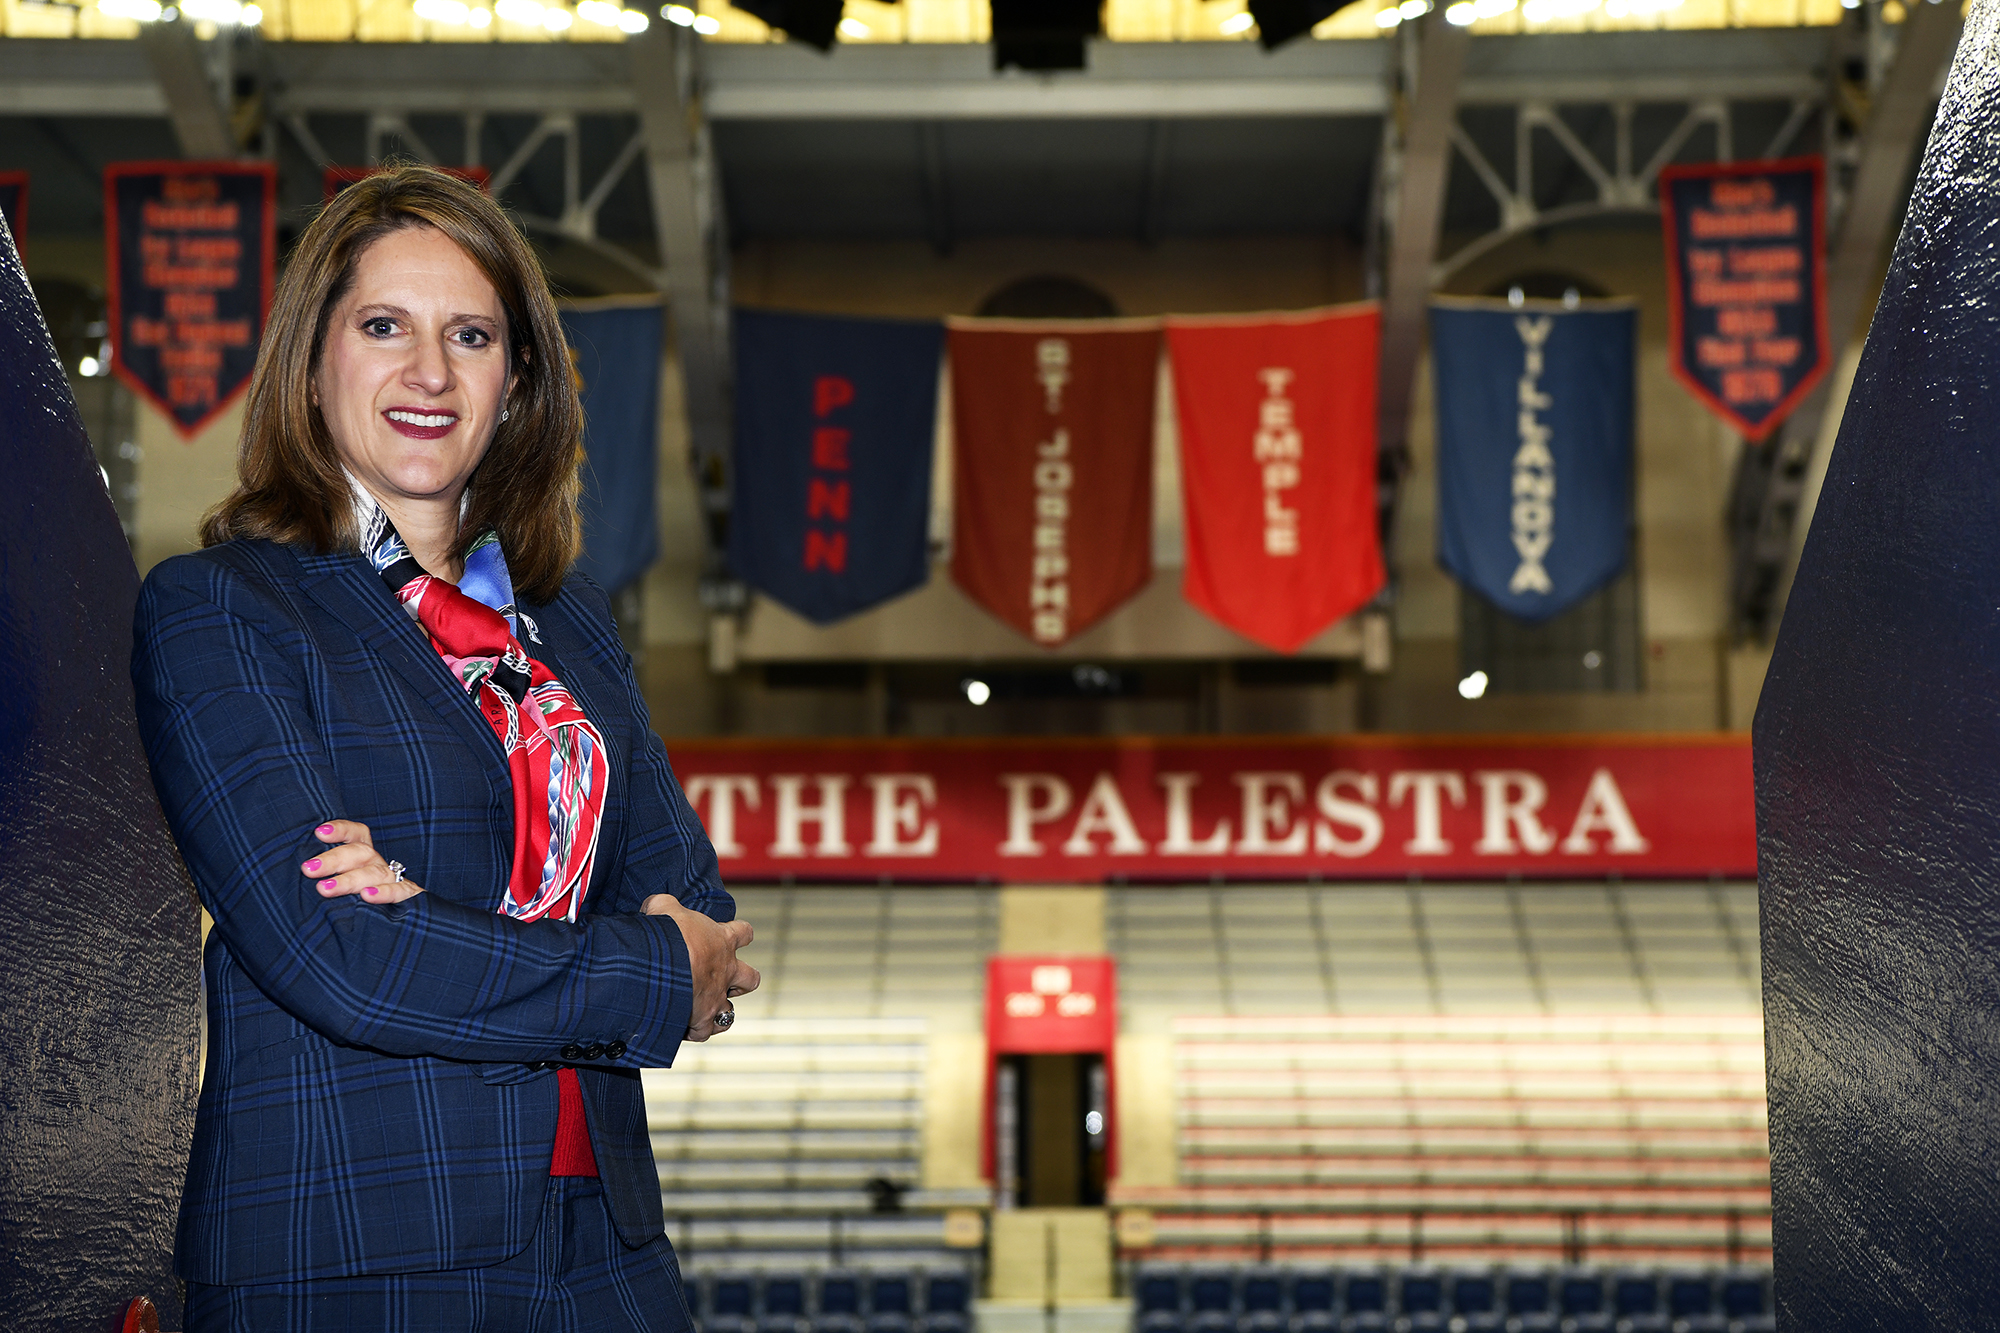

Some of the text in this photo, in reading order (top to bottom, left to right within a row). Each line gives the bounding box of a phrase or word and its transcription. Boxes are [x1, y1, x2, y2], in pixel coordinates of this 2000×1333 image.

[803, 376, 855, 574] PENN
[1254, 367, 1303, 557] TEMPLE
[1508, 315, 1556, 595] VILLANOVA
[685, 769, 1649, 858] THE PALESTRA
